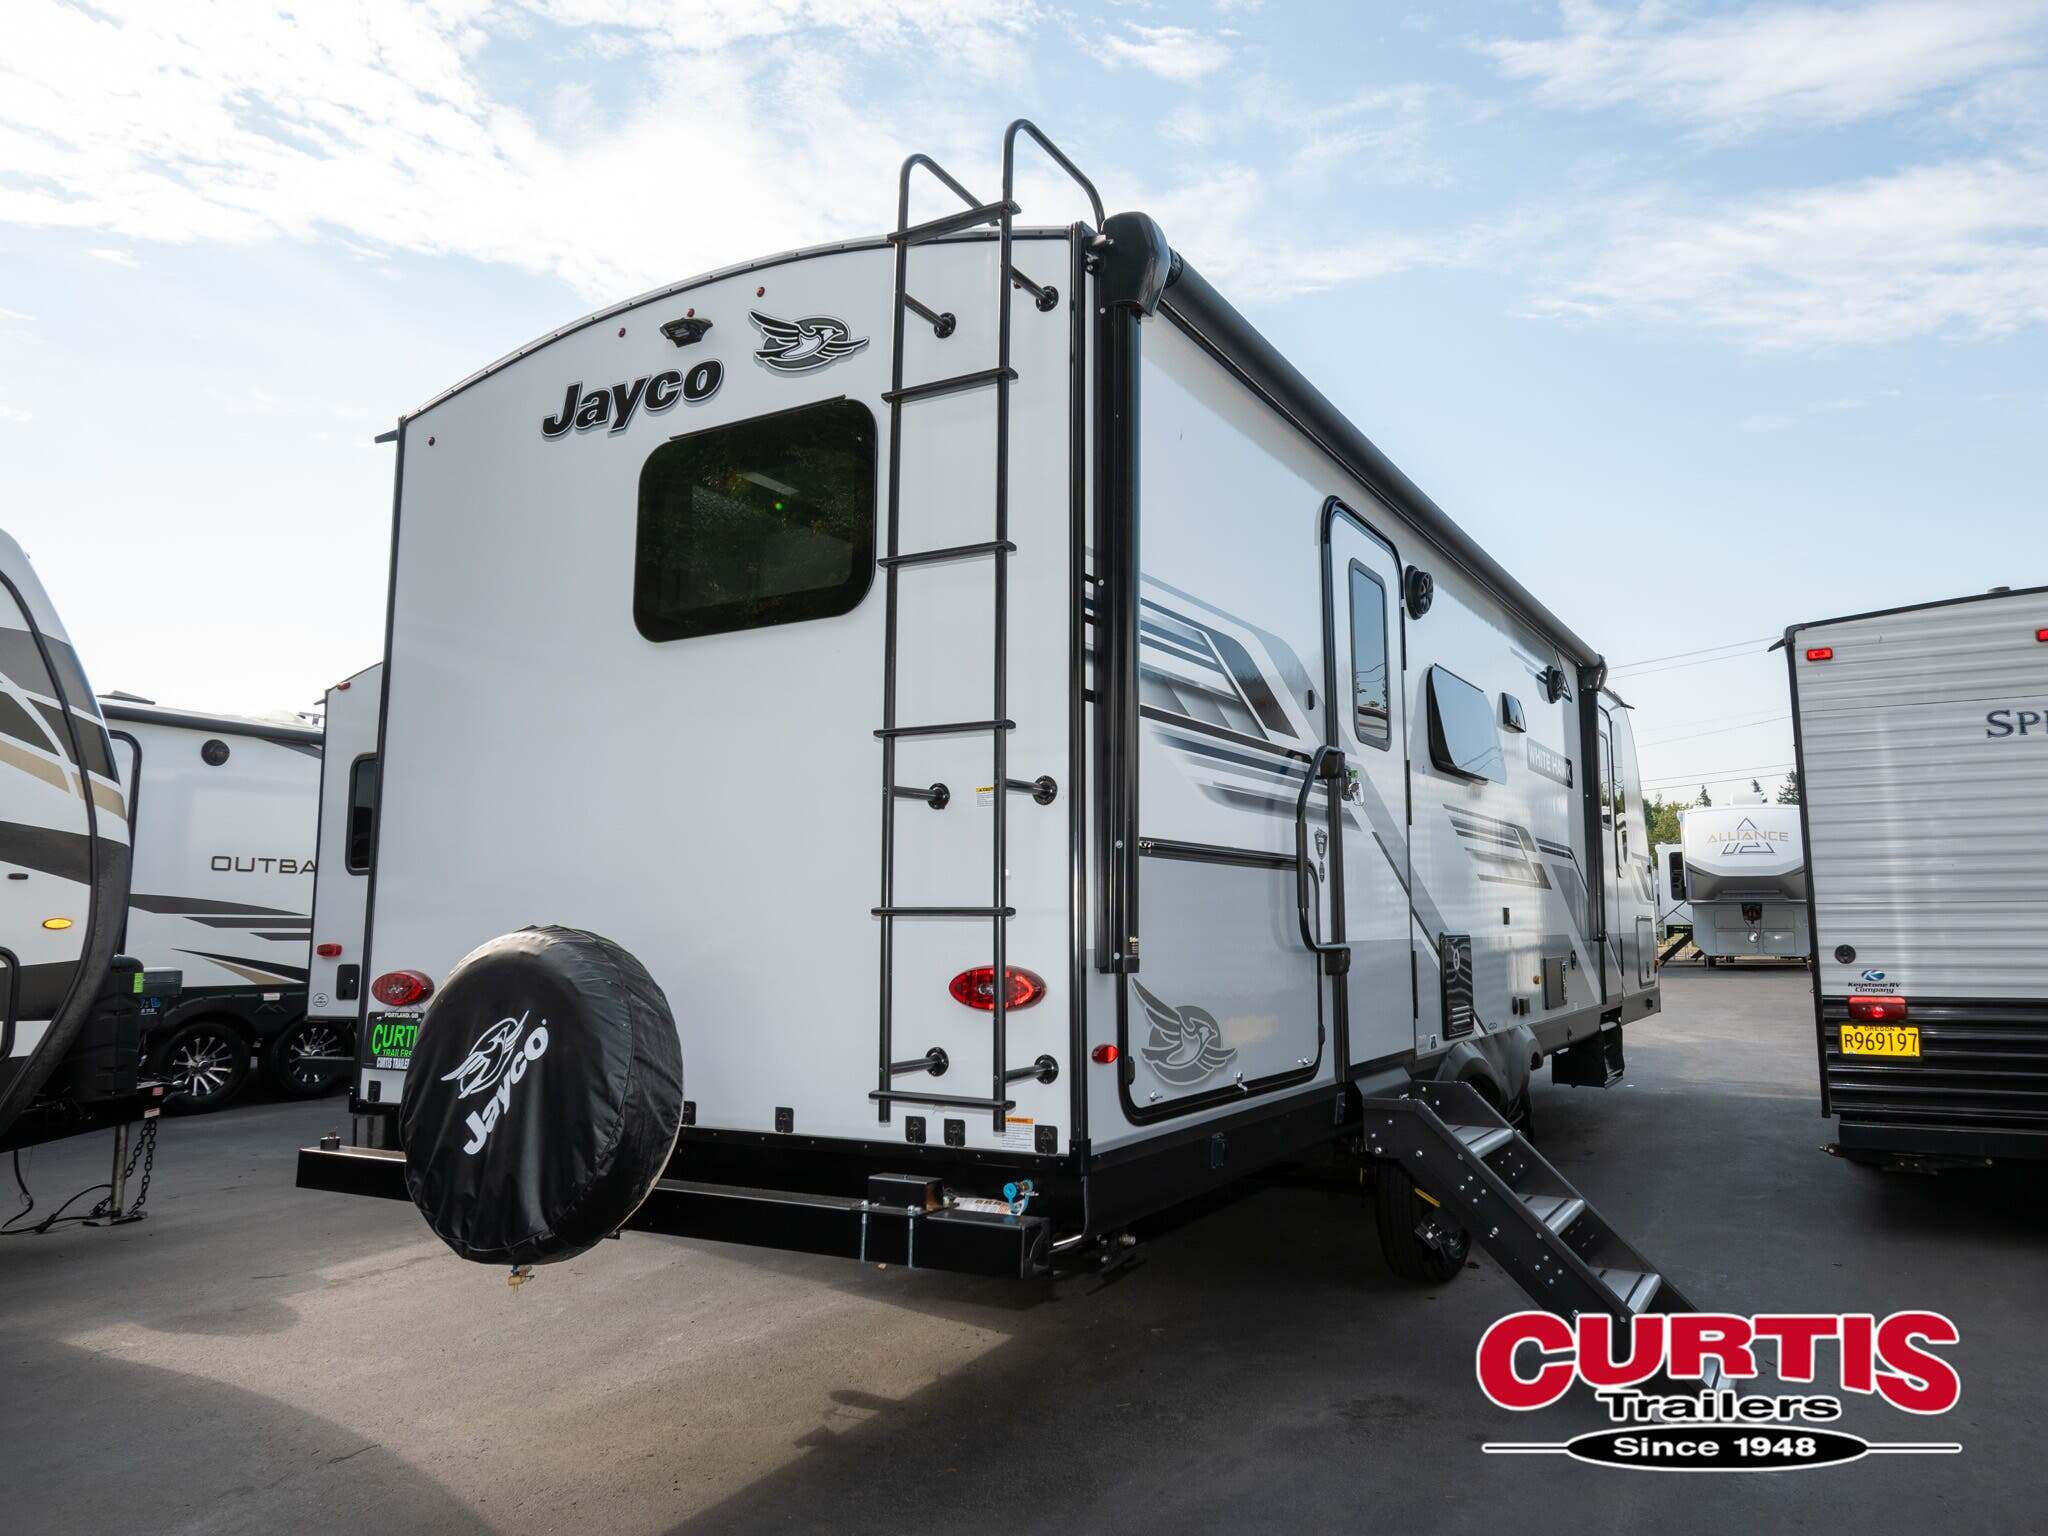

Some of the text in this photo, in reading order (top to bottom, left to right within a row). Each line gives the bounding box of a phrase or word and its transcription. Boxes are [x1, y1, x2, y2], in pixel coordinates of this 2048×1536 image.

[541, 358, 725, 438] Jayco
[1707, 831, 1789, 844] ALLIANCE
[211, 855, 316, 874] OUTBA
[372, 1023, 418, 1055] CURTI
[1844, 1031, 1917, 1052] R969197
[393, 1057, 411, 1069] TRAILE
[463, 1026, 549, 1155] Jayco
